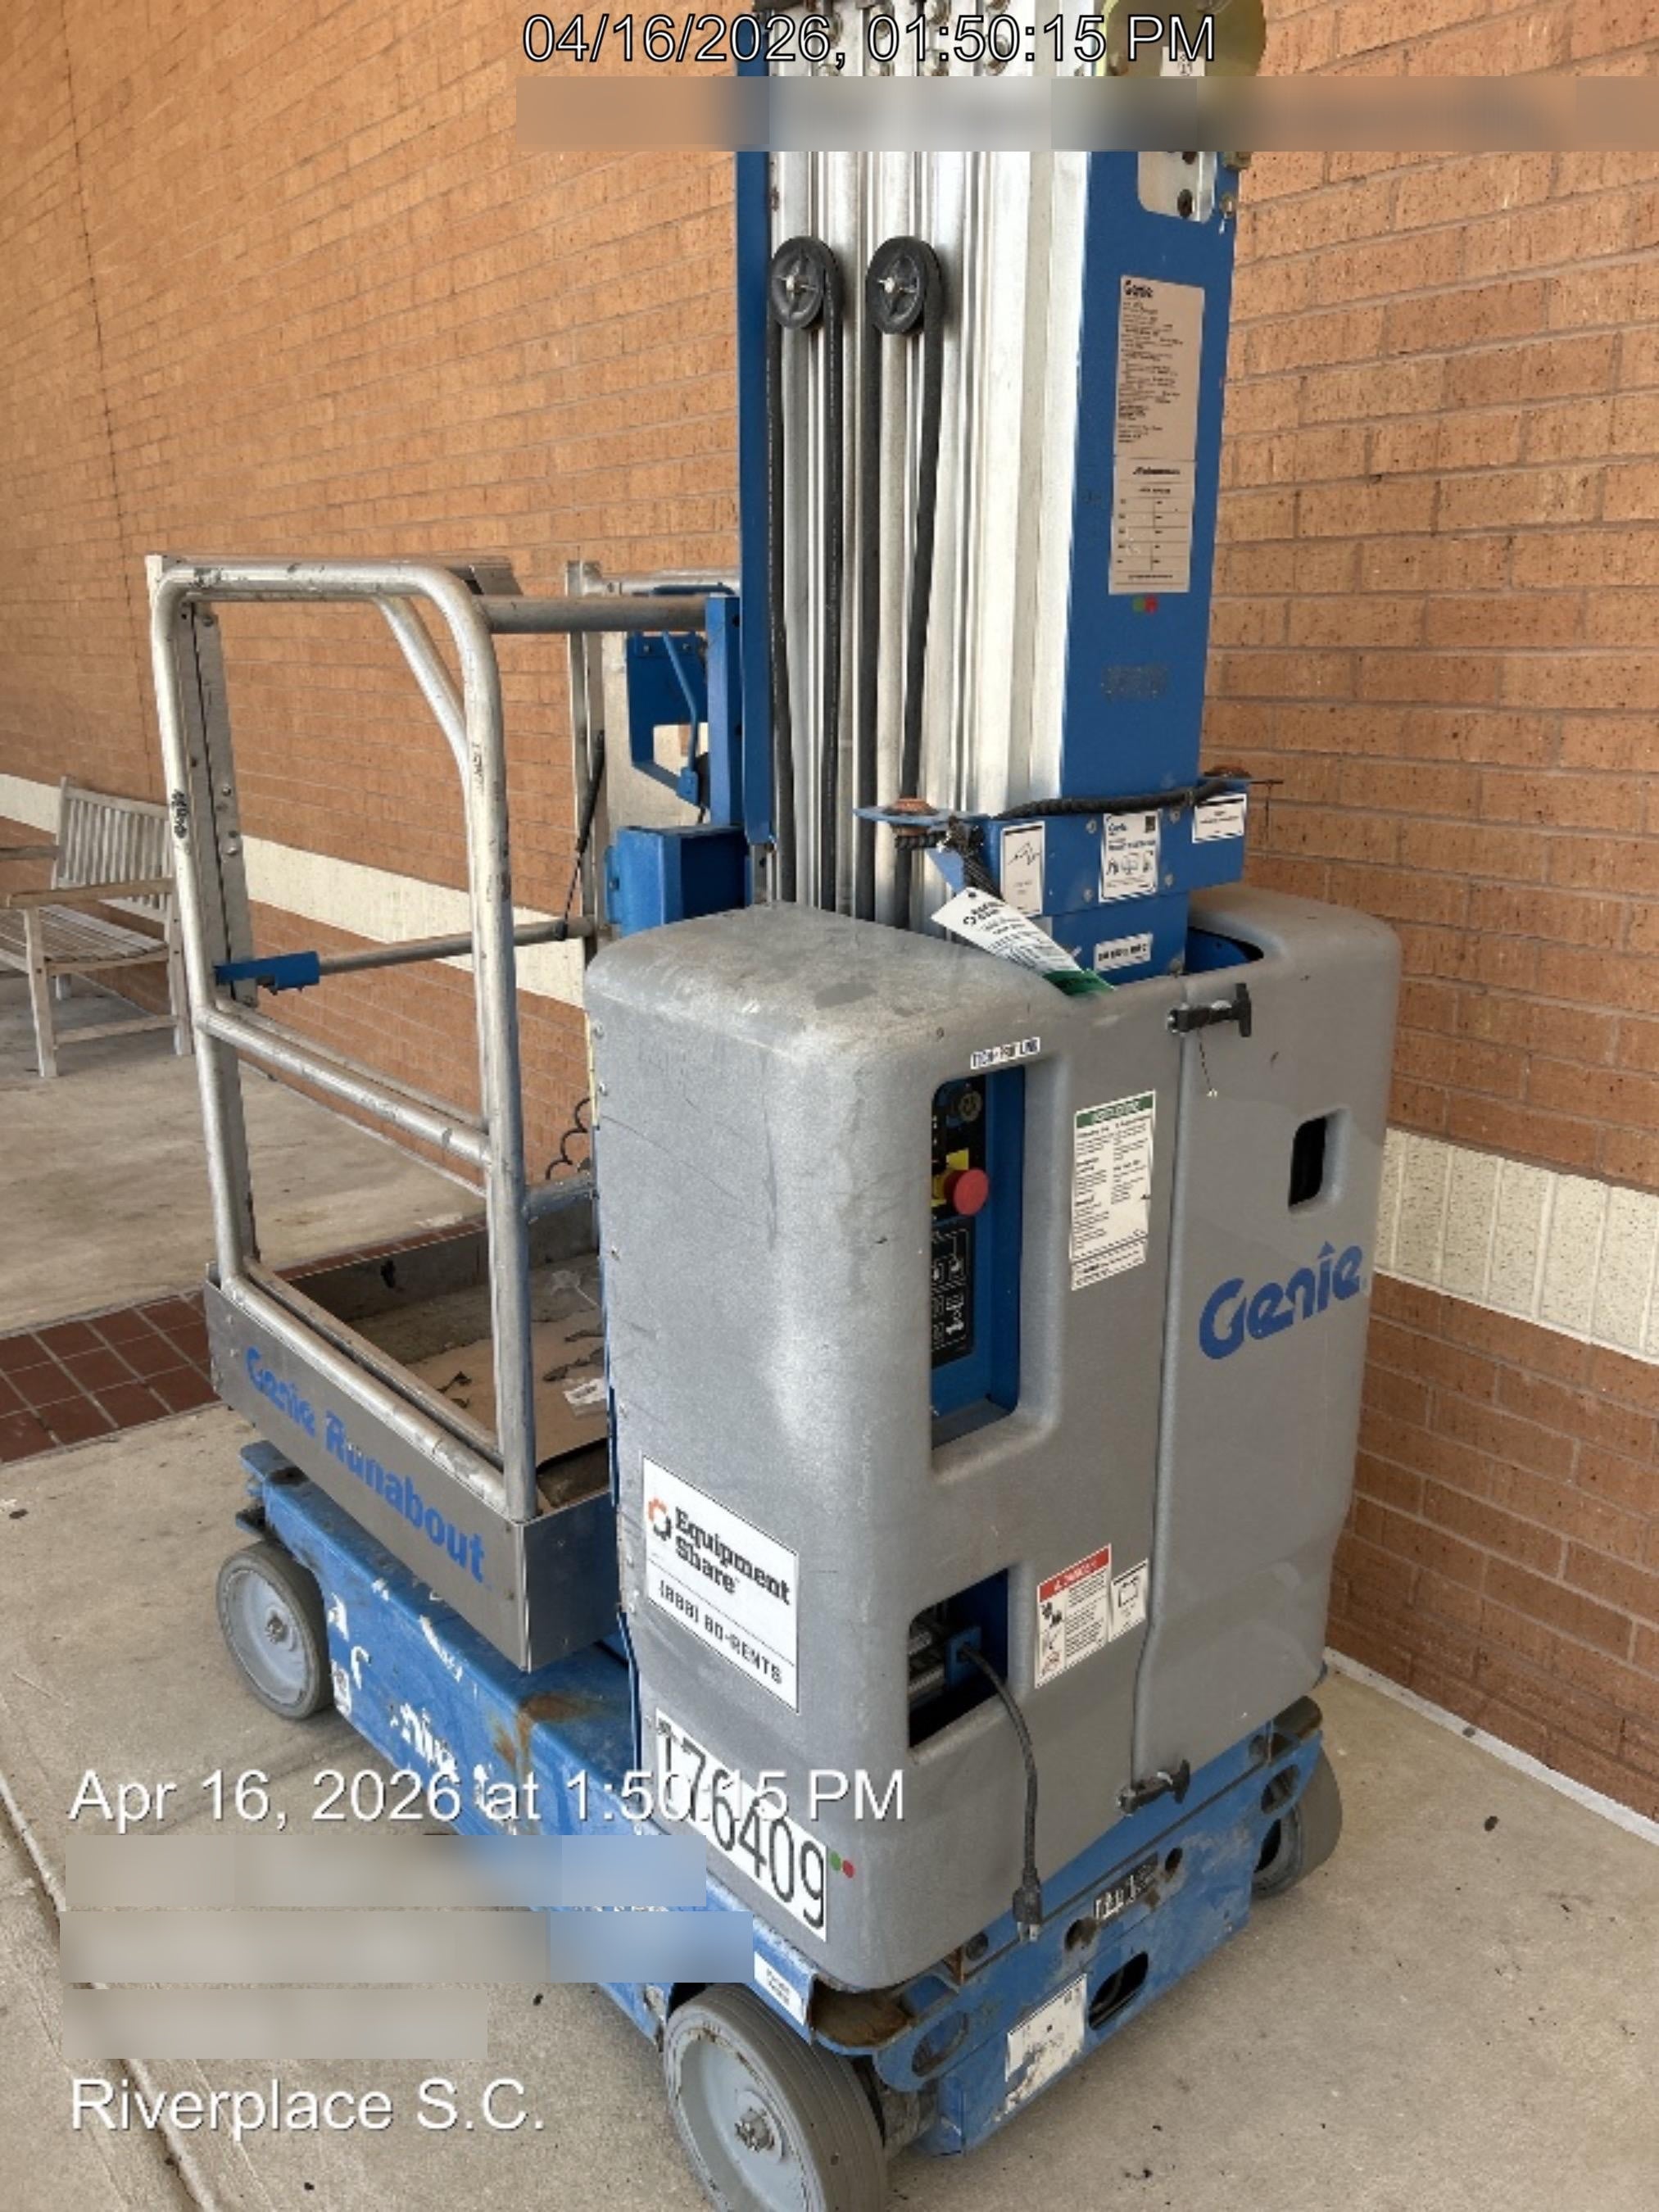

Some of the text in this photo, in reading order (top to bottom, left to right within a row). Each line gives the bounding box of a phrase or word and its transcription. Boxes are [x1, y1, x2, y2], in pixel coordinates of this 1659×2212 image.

[1199, 1240, 1363, 1360] Genie
[244, 1346, 485, 1583] Genie Runabout
[675, 1506, 791, 1606] Equipment
[675, 1534, 737, 1595] Share
